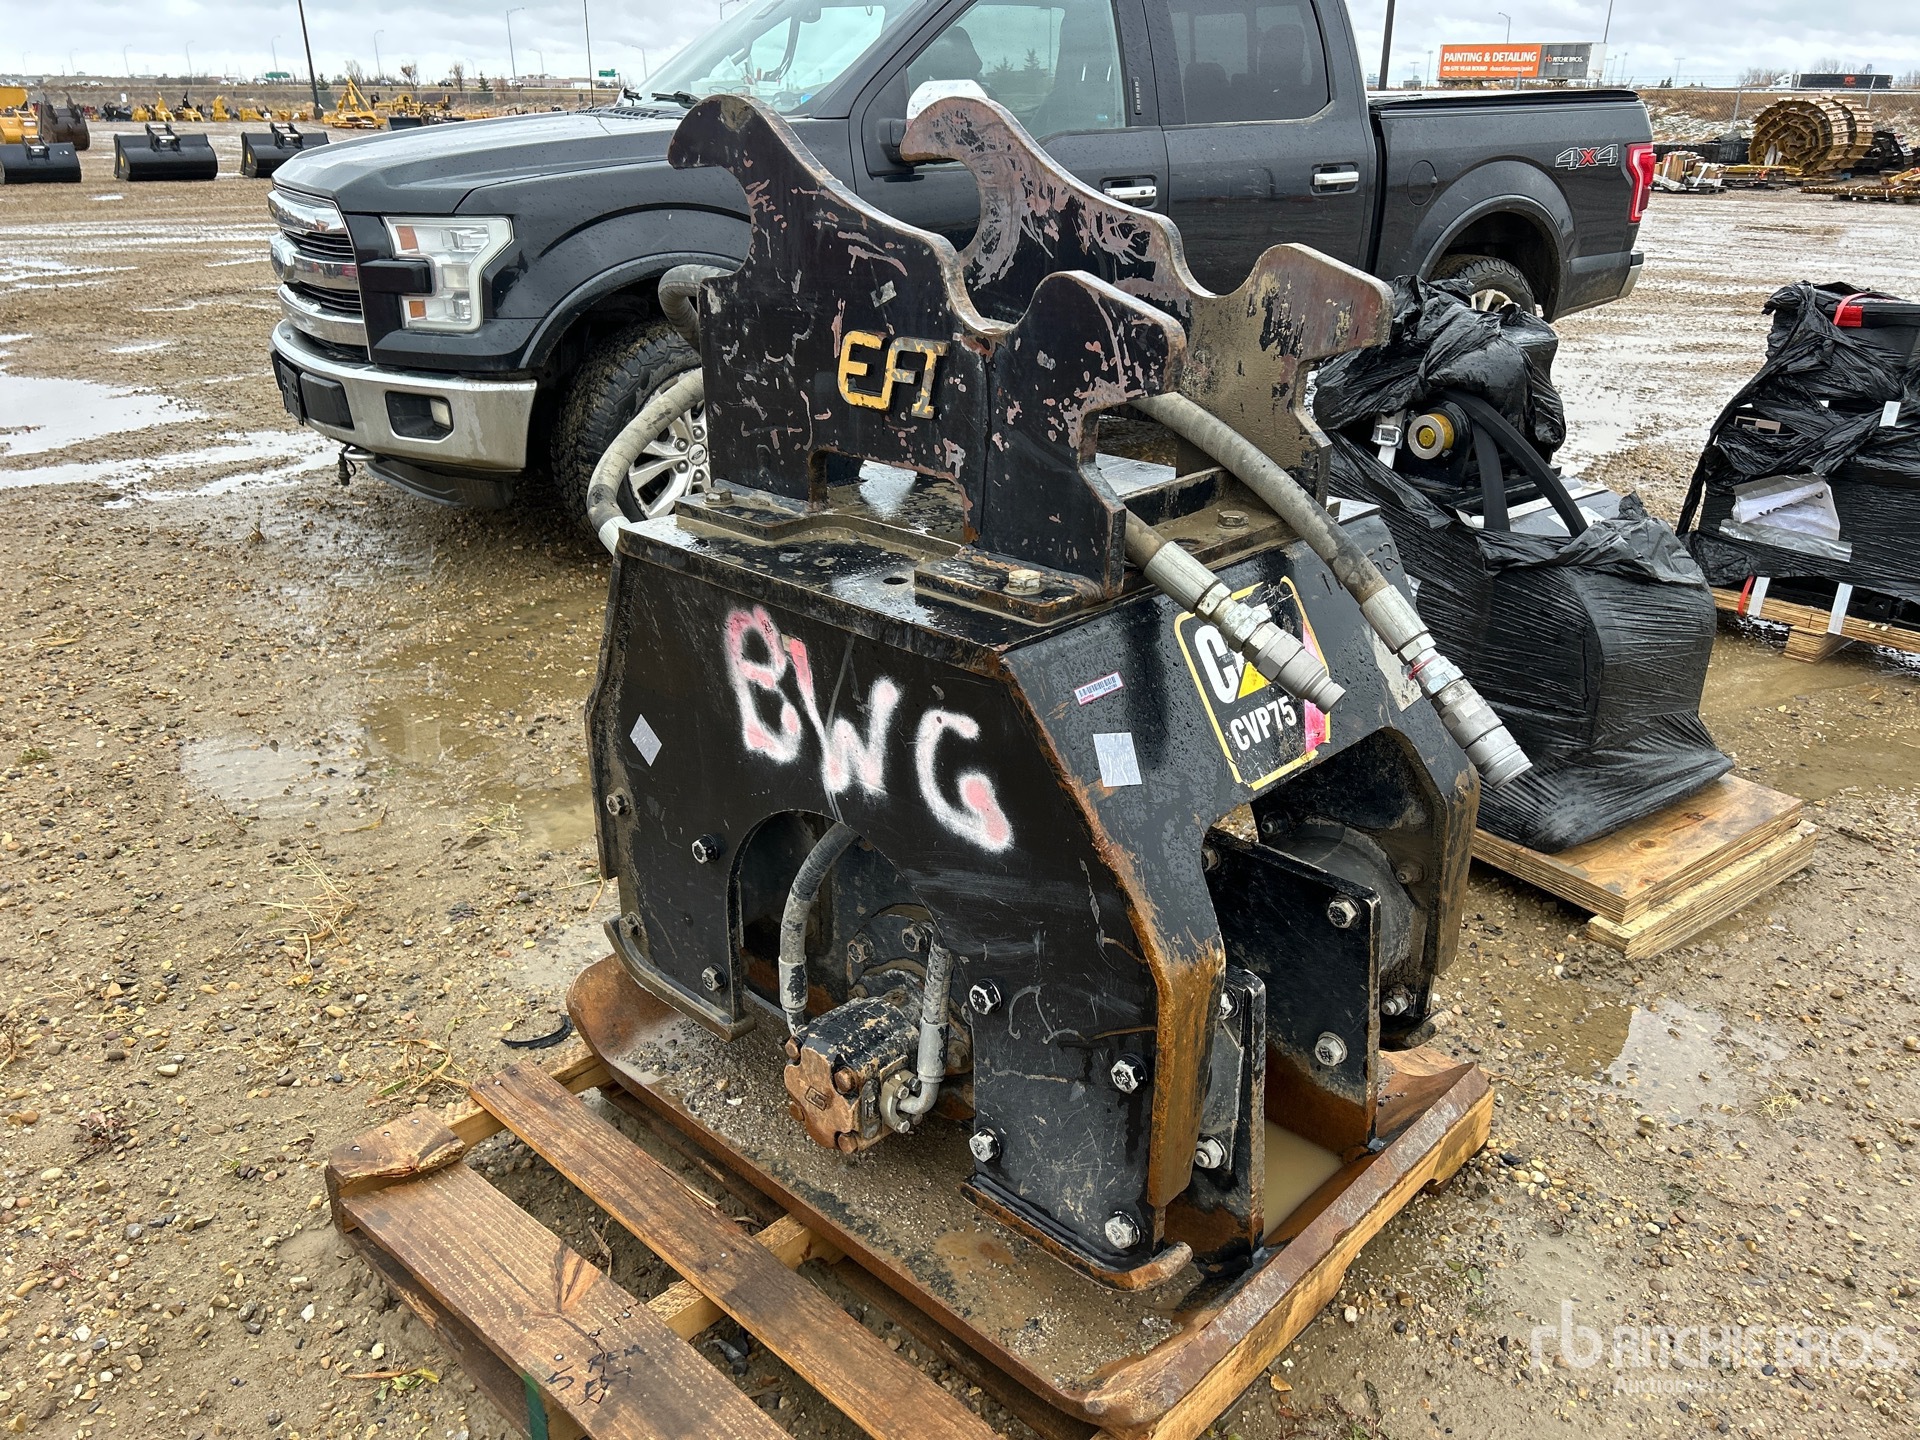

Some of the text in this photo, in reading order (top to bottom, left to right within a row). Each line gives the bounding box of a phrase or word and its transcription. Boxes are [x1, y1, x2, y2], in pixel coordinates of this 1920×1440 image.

[1444, 52, 1537, 62] PAINTING & DETAILING
[1230, 696, 1297, 750] CVP75
